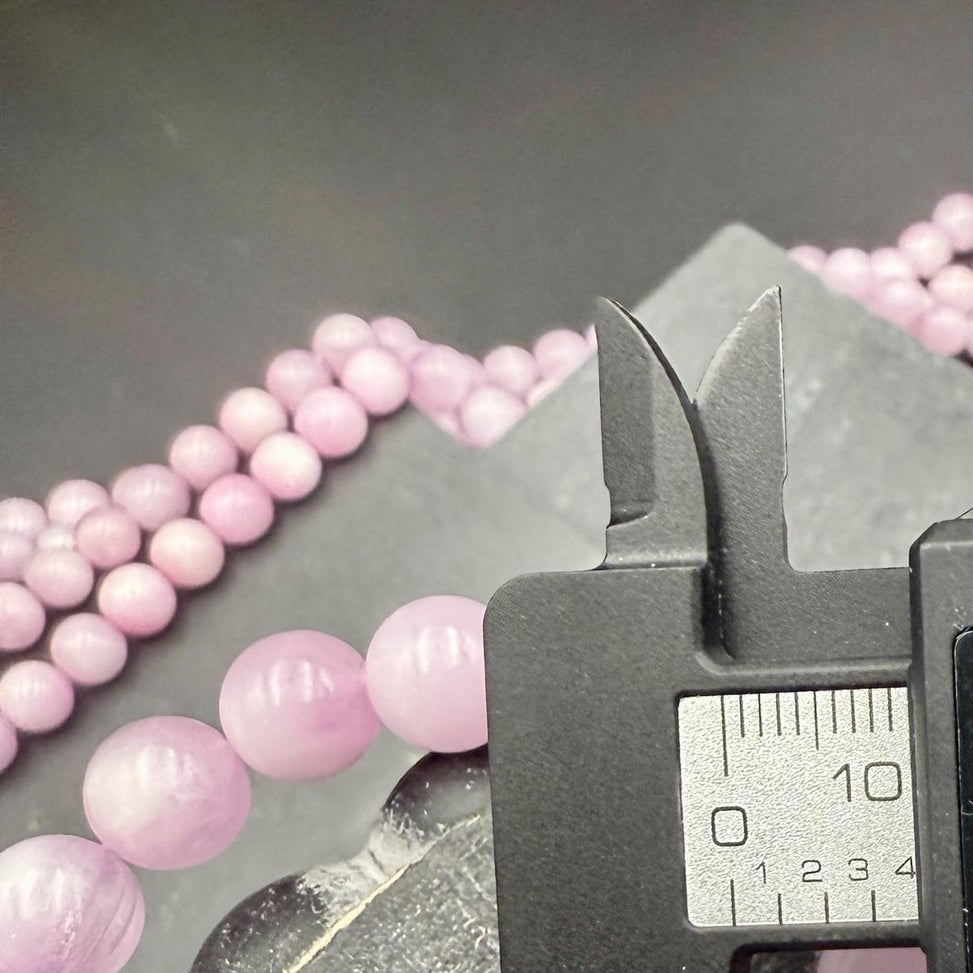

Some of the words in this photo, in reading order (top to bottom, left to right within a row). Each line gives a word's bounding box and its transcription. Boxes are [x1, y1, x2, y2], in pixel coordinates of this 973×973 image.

[711, 806, 748, 847] 0
[833, 763, 902, 802] 10
[755, 861, 767, 884] 1
[801, 859, 823, 882] 2
[848, 858, 869, 881] 3
[895, 856, 916, 879] 4
